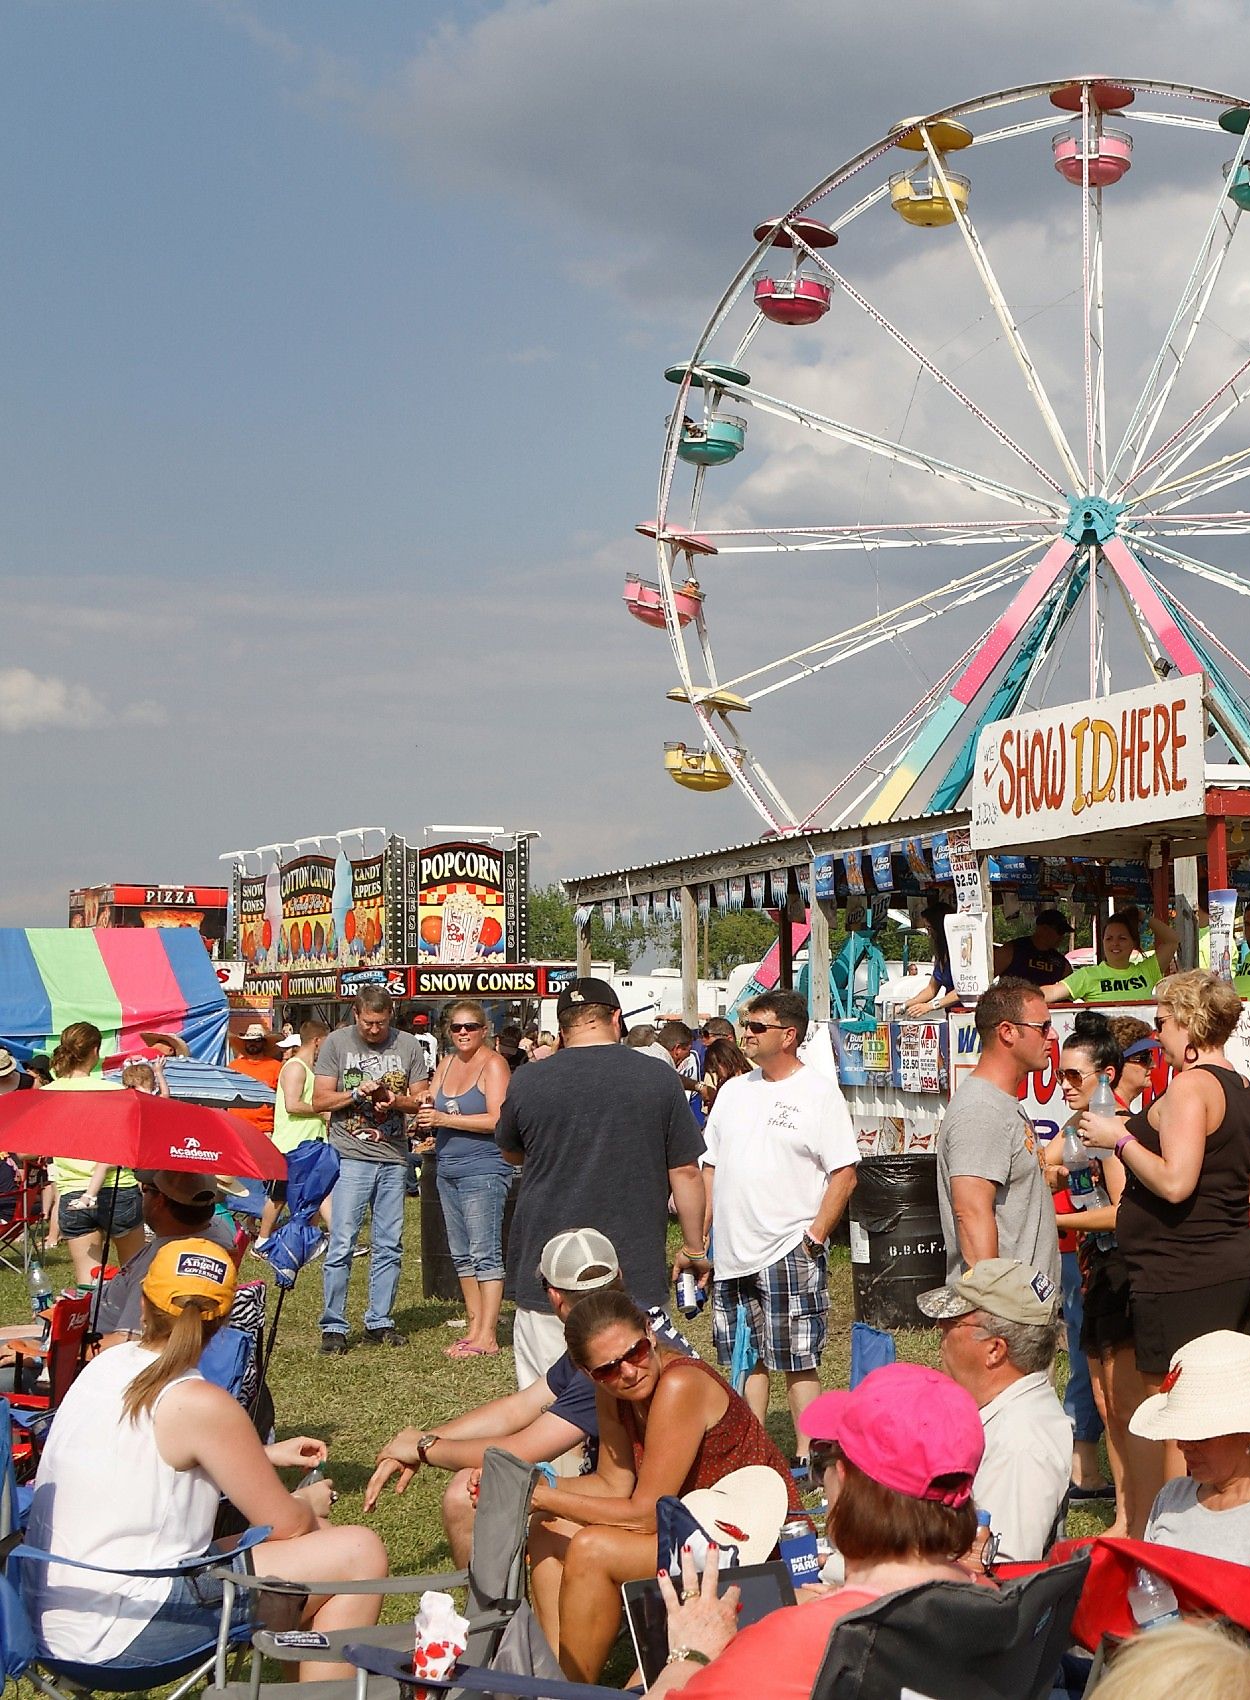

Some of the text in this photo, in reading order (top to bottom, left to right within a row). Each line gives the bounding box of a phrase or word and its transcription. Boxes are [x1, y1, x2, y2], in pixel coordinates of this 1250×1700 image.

[998, 699, 1187, 818] SHOW I.D. HERE
[354, 863, 382, 881] CANDY
[420, 851, 501, 885] POPCORN
[281, 865, 334, 897] COTTON CANDY
[956, 872, 979, 887] $2.50
[145, 890, 196, 905] PIZZA
[242, 882, 264, 897] SNOW
[354, 881, 382, 898] APPLES
[242, 899, 264, 913] CONES
[408, 862, 416, 948] FRESH
[506, 863, 515, 949] SWEETS
[1029, 959, 1053, 972] LSU
[243, 980, 282, 997] OPCORN
[289, 975, 337, 995] COTTON CANDY
[340, 982, 406, 996] DRKS
[420, 973, 475, 992] SNOW
[476, 972, 535, 991] CONES
[956, 981, 979, 993] $2.50
[920, 1077, 937, 1089] 1994
[169, 1146, 219, 1161] Academy
[181, 1257, 224, 1275] Angelle
